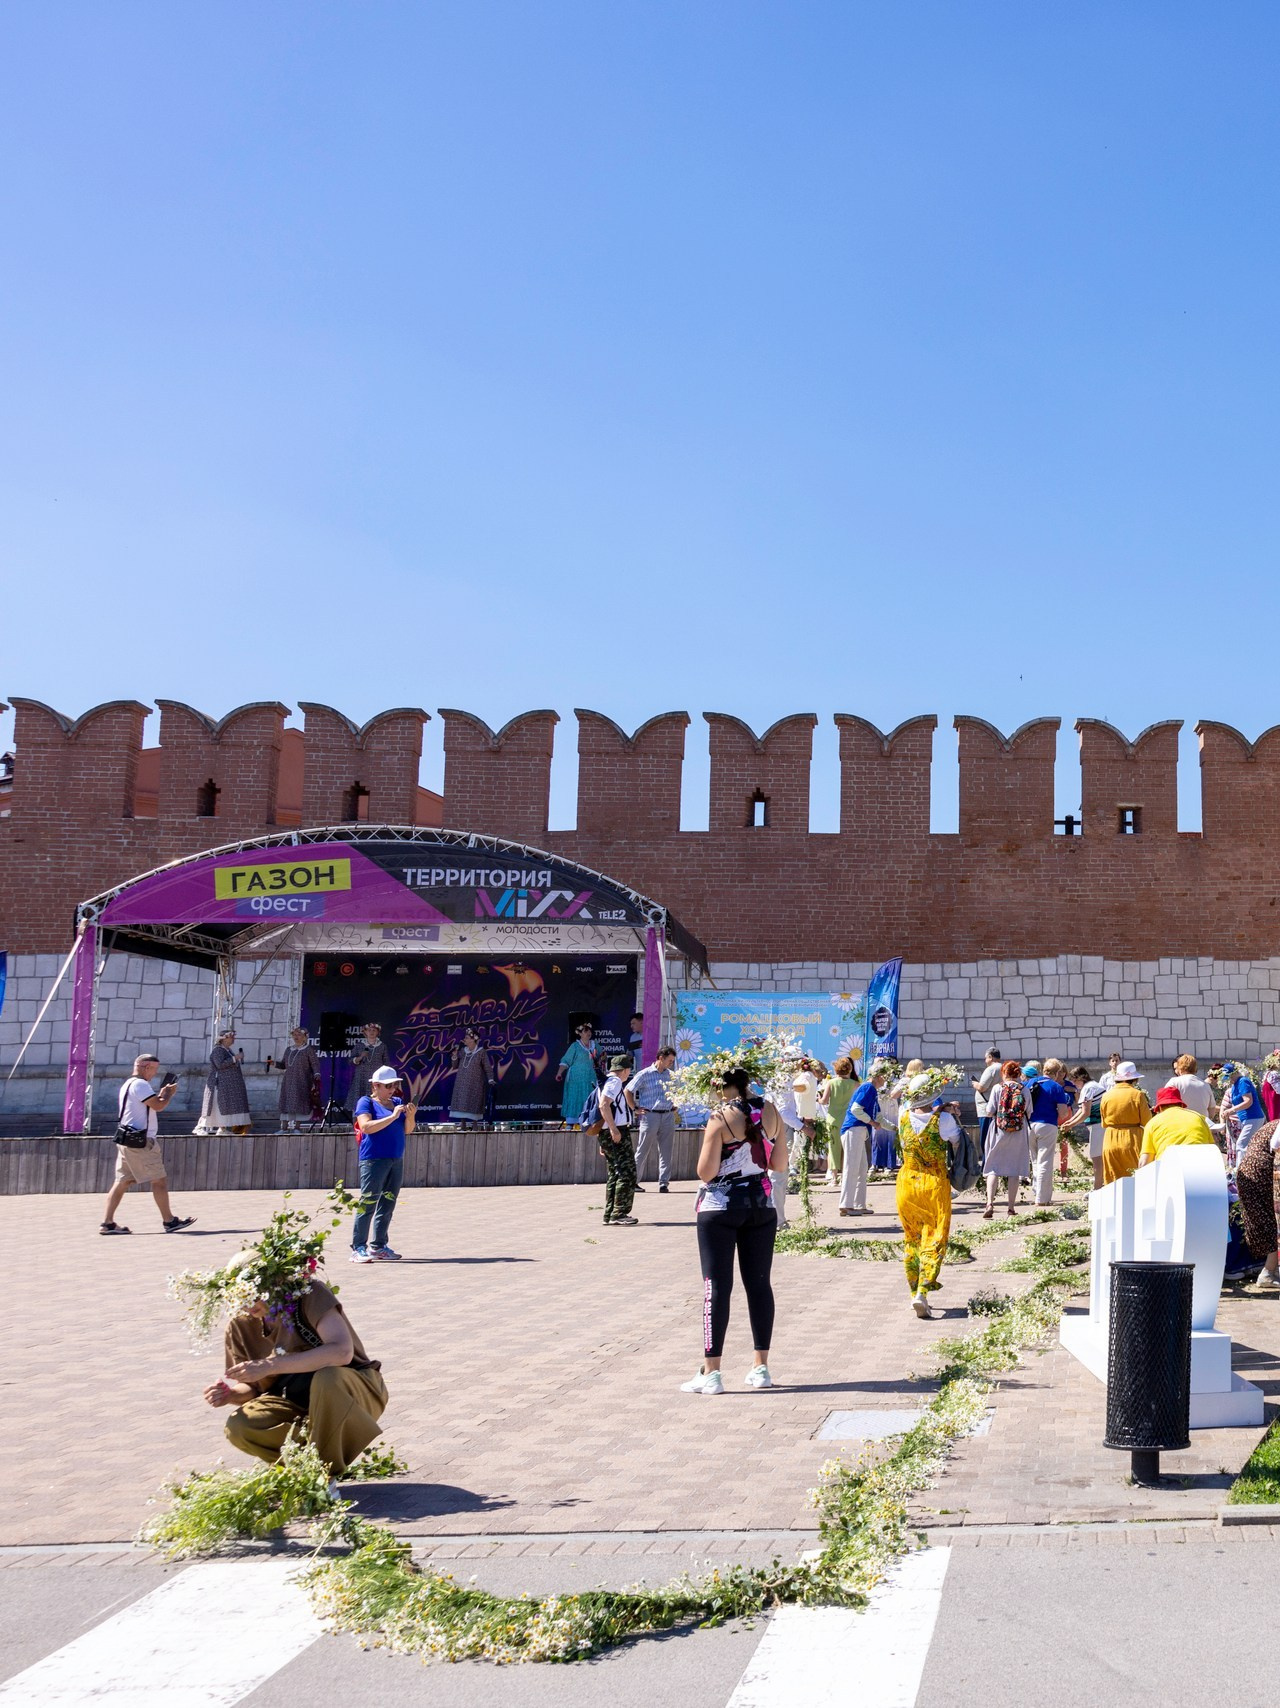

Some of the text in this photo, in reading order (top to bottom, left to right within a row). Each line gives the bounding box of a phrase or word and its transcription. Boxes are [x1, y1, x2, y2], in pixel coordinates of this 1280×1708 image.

[231, 865, 335, 893] ГАЗОН
[402, 868, 552, 888] ТЕРРИТОРИЯ
[250, 896, 311, 915] фест
[598, 909, 627, 920] TELE2
[391, 927, 430, 939] фест
[495, 926, 559, 935] МОЛОДОСТИ
[720, 1011, 822, 1025] РОМАШКОВЫЙ
[739, 1025, 805, 1037] ХОРОВОД
